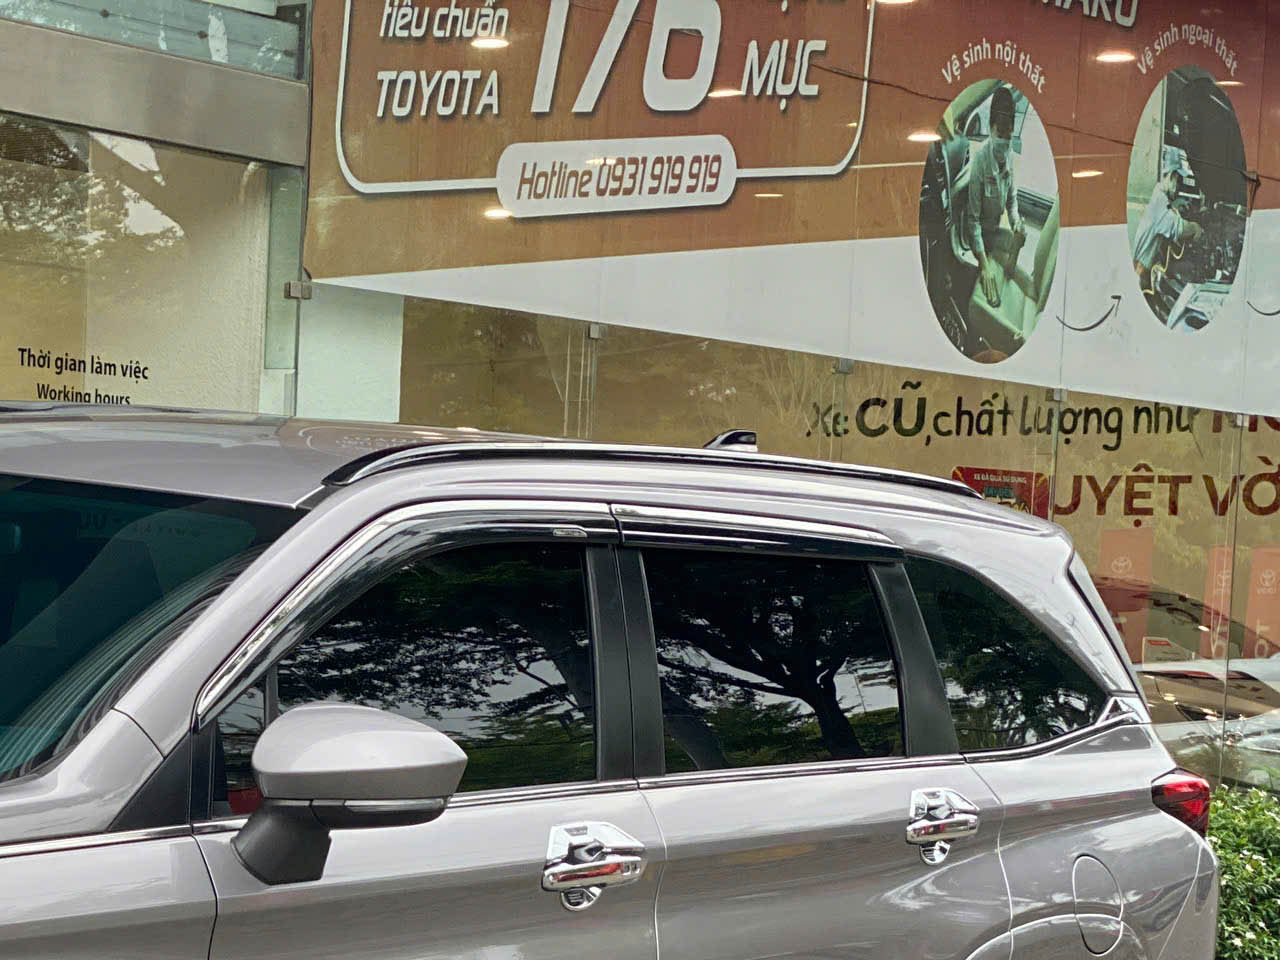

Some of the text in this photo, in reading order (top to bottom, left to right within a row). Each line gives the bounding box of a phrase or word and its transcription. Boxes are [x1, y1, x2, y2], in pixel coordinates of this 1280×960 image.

[740, 39, 828, 111] MỤC
[941, 37, 1047, 94] Vệ sinh nội thất
[1136, 23, 1239, 77] Vệ sinh ngoại thất
[376, 69, 499, 118] TOYOTA
[516, 154, 722, 200] Hotline 0931 919 919
[18, 347, 149, 385] Thời gian làm việc
[36, 382, 131, 406] Working hours
[1019, 394, 1124, 452] lượng
